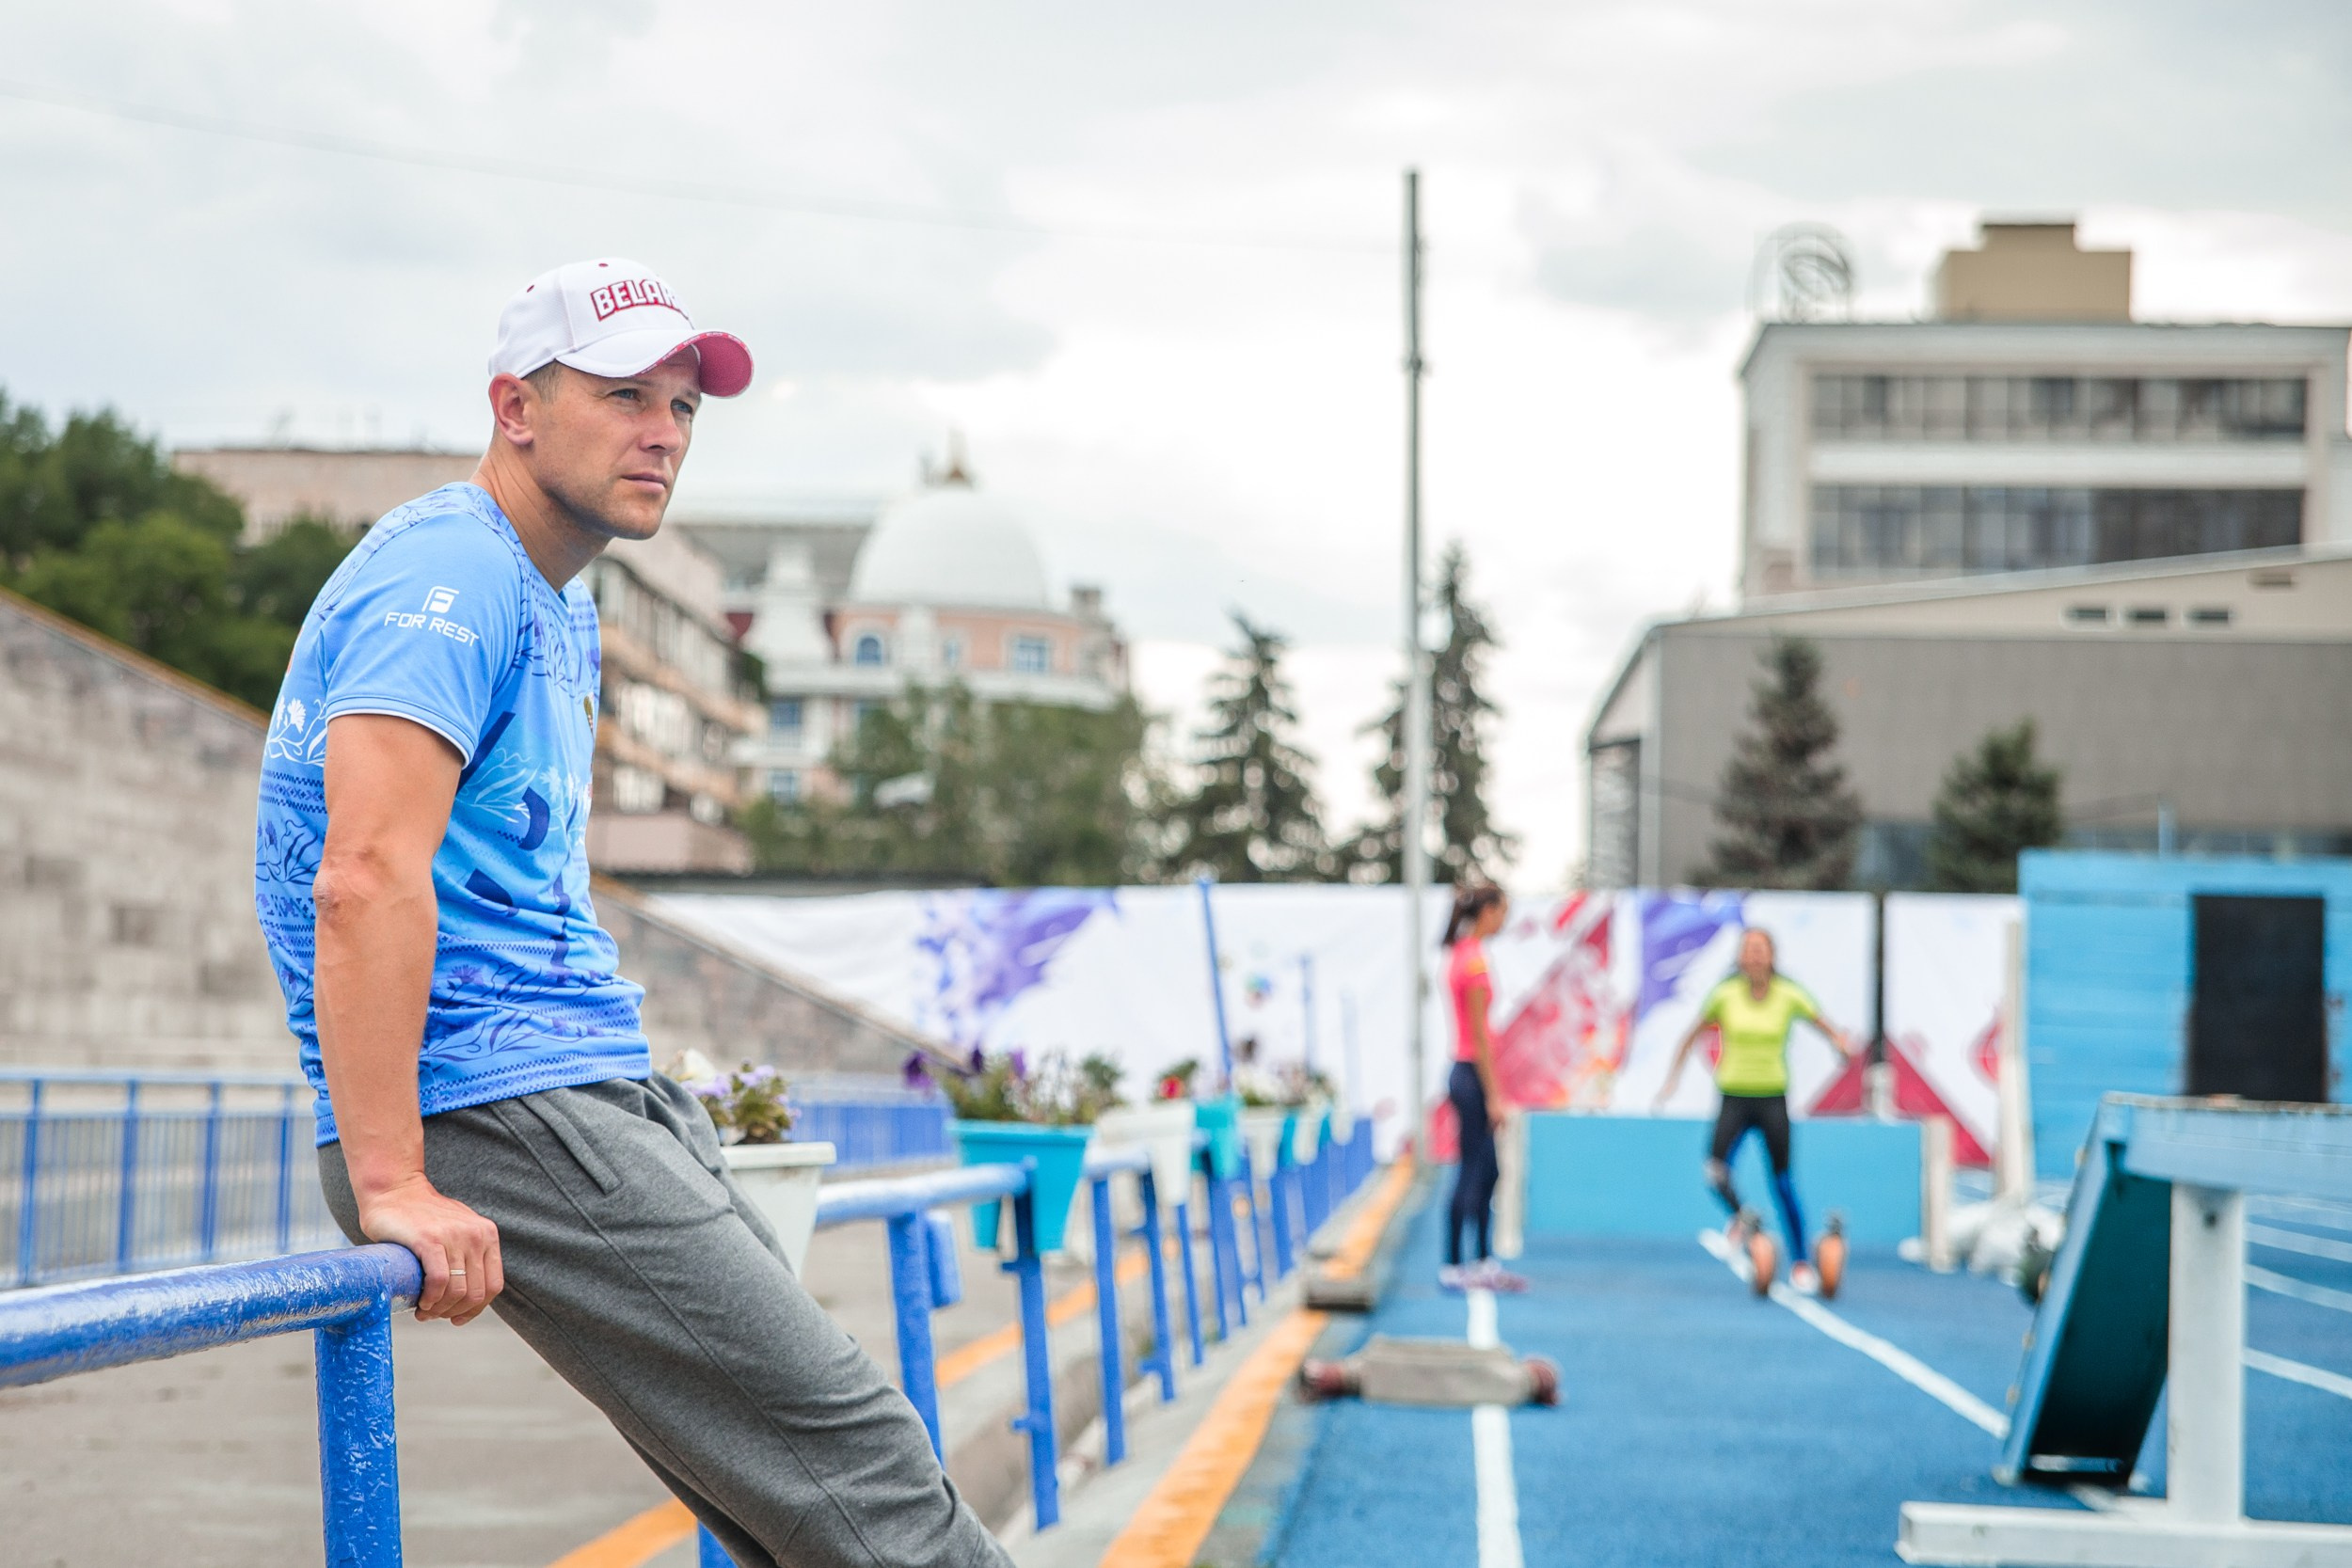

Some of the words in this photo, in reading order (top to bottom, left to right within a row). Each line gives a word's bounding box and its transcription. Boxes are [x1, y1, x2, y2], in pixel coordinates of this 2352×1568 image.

[590, 278, 691, 325] BELAR
[384, 611, 427, 629] FOR
[428, 616, 480, 647] REST
